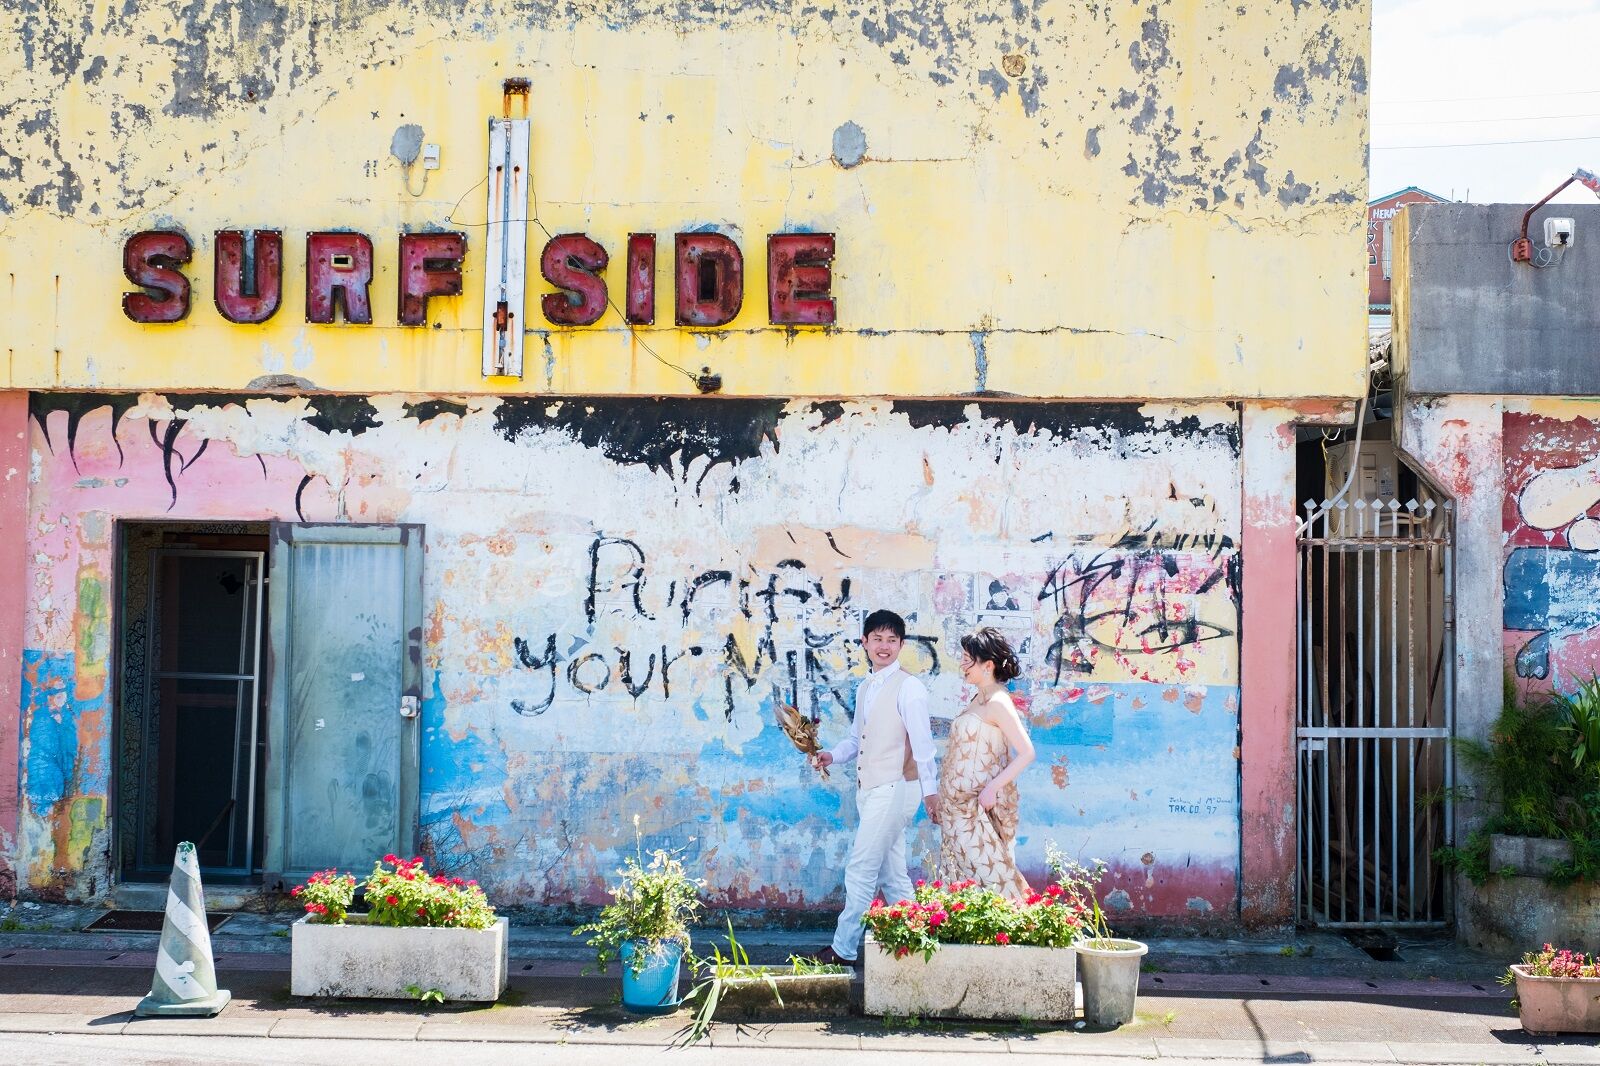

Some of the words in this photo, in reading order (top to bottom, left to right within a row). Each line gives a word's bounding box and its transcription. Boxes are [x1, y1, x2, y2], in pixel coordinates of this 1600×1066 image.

[122, 230, 466, 326] SURF
[540, 231, 837, 328] SIDE
[510, 632, 702, 717] your
